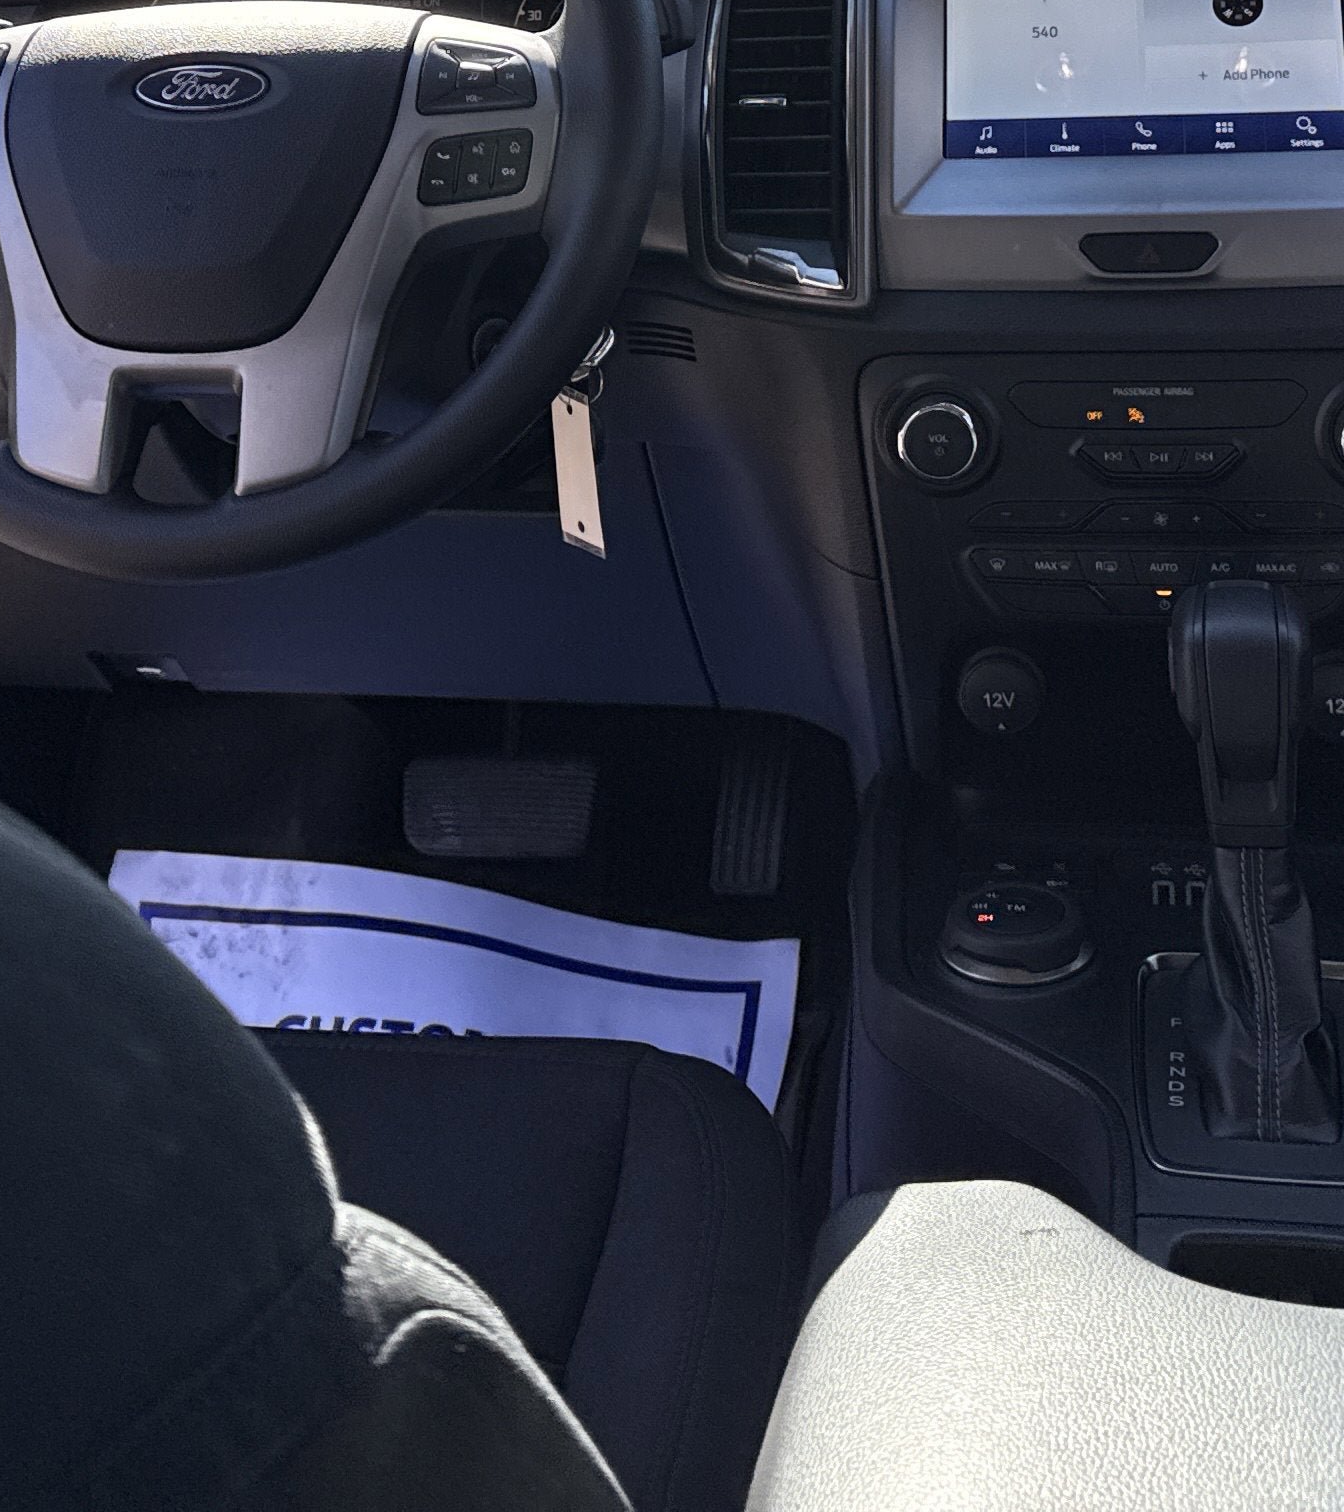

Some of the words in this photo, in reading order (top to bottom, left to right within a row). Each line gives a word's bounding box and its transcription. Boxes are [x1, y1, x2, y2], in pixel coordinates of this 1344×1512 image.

[527, 10, 542, 21] 30
[1032, 26, 1058, 38] 540
[1223, 68, 1248, 81] Add
[1250, 66, 1290, 80] Phone
[161, 71, 241, 101] Ford
[1049, 143, 1080, 153] Climate
[1131, 142, 1157, 151] Phone
[1214, 140, 1236, 151] Apps
[1290, 137, 1325, 149] Settings
[975, 146, 998, 155] Audio
[1113, 387, 1161, 396] PASSENGER
[1164, 387, 1195, 396] AIRBAG
[1086, 411, 1103, 421] OFF
[929, 434, 948, 443] VOL
[1035, 561, 1057, 571] MAX
[1149, 563, 1179, 572] AUTO
[1210, 562, 1231, 573] A/C
[983, 692, 1015, 709] 12V
[1170, 1052, 1184, 1062] R
[1169, 1066, 1185, 1077] N
[1168, 1081, 1185, 1092] D
[1168, 1095, 1185, 1107] S
